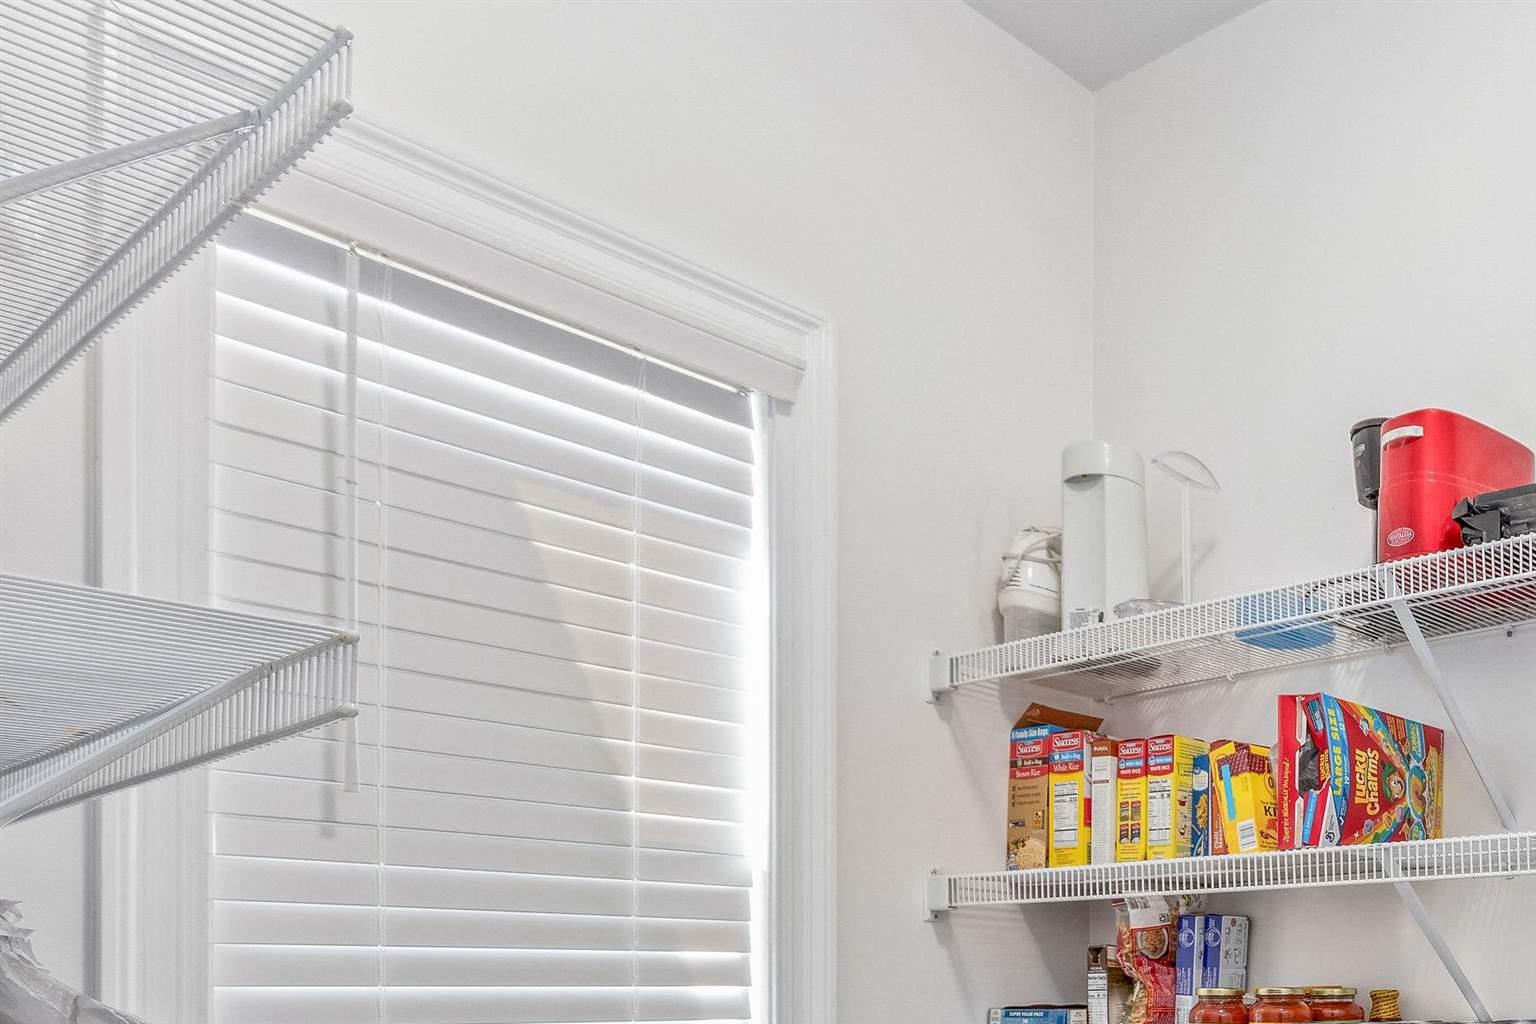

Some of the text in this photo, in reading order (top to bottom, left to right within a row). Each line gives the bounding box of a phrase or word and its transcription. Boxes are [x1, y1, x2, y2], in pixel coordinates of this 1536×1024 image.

[1054, 737, 1080, 746] Success
[1017, 744, 1041, 753] Success
[1120, 747, 1142, 755] Success
[1149, 743, 1172, 752] Success
[1328, 707, 1344, 796] LARGE SIZE
[1354, 748, 1369, 804] Lucky
[1365, 747, 1381, 816] Charms
